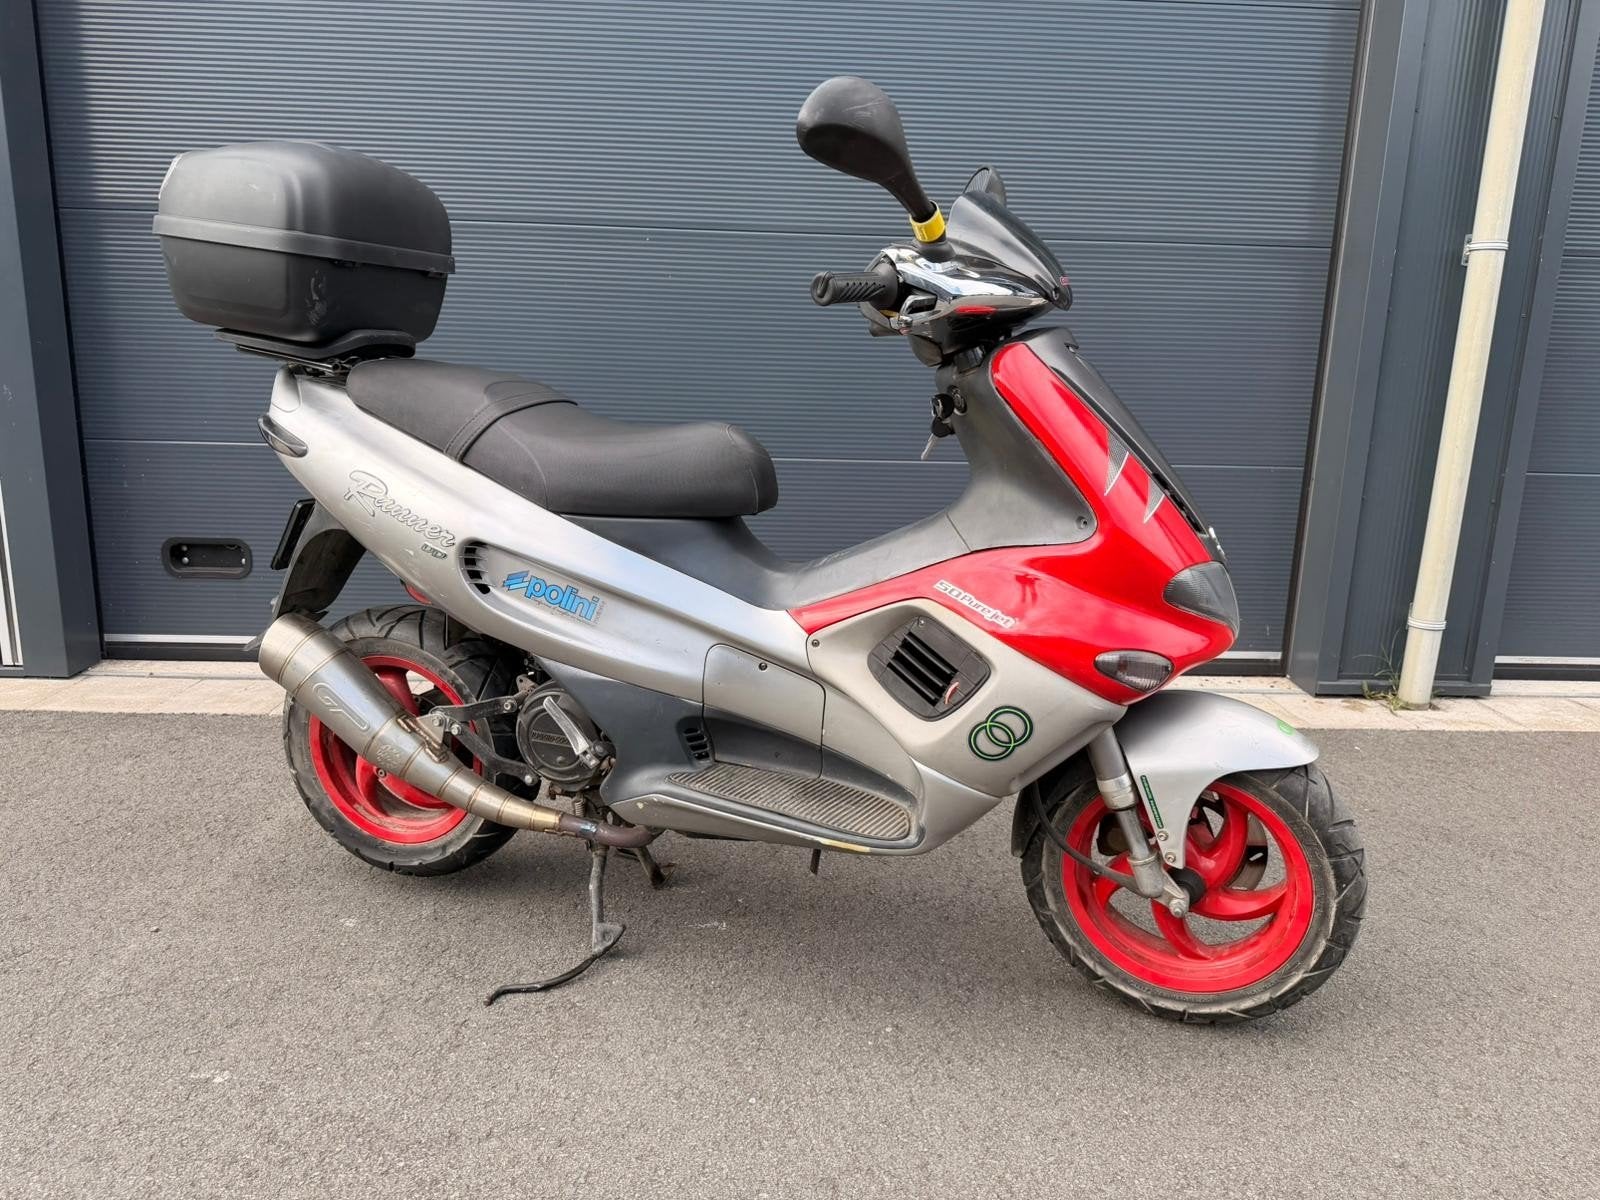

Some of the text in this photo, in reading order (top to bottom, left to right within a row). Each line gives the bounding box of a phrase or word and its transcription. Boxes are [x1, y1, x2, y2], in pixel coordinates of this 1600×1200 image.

[343, 469, 455, 547] Runner
[524, 575, 600, 621] polini
[935, 580, 963, 599] 50
